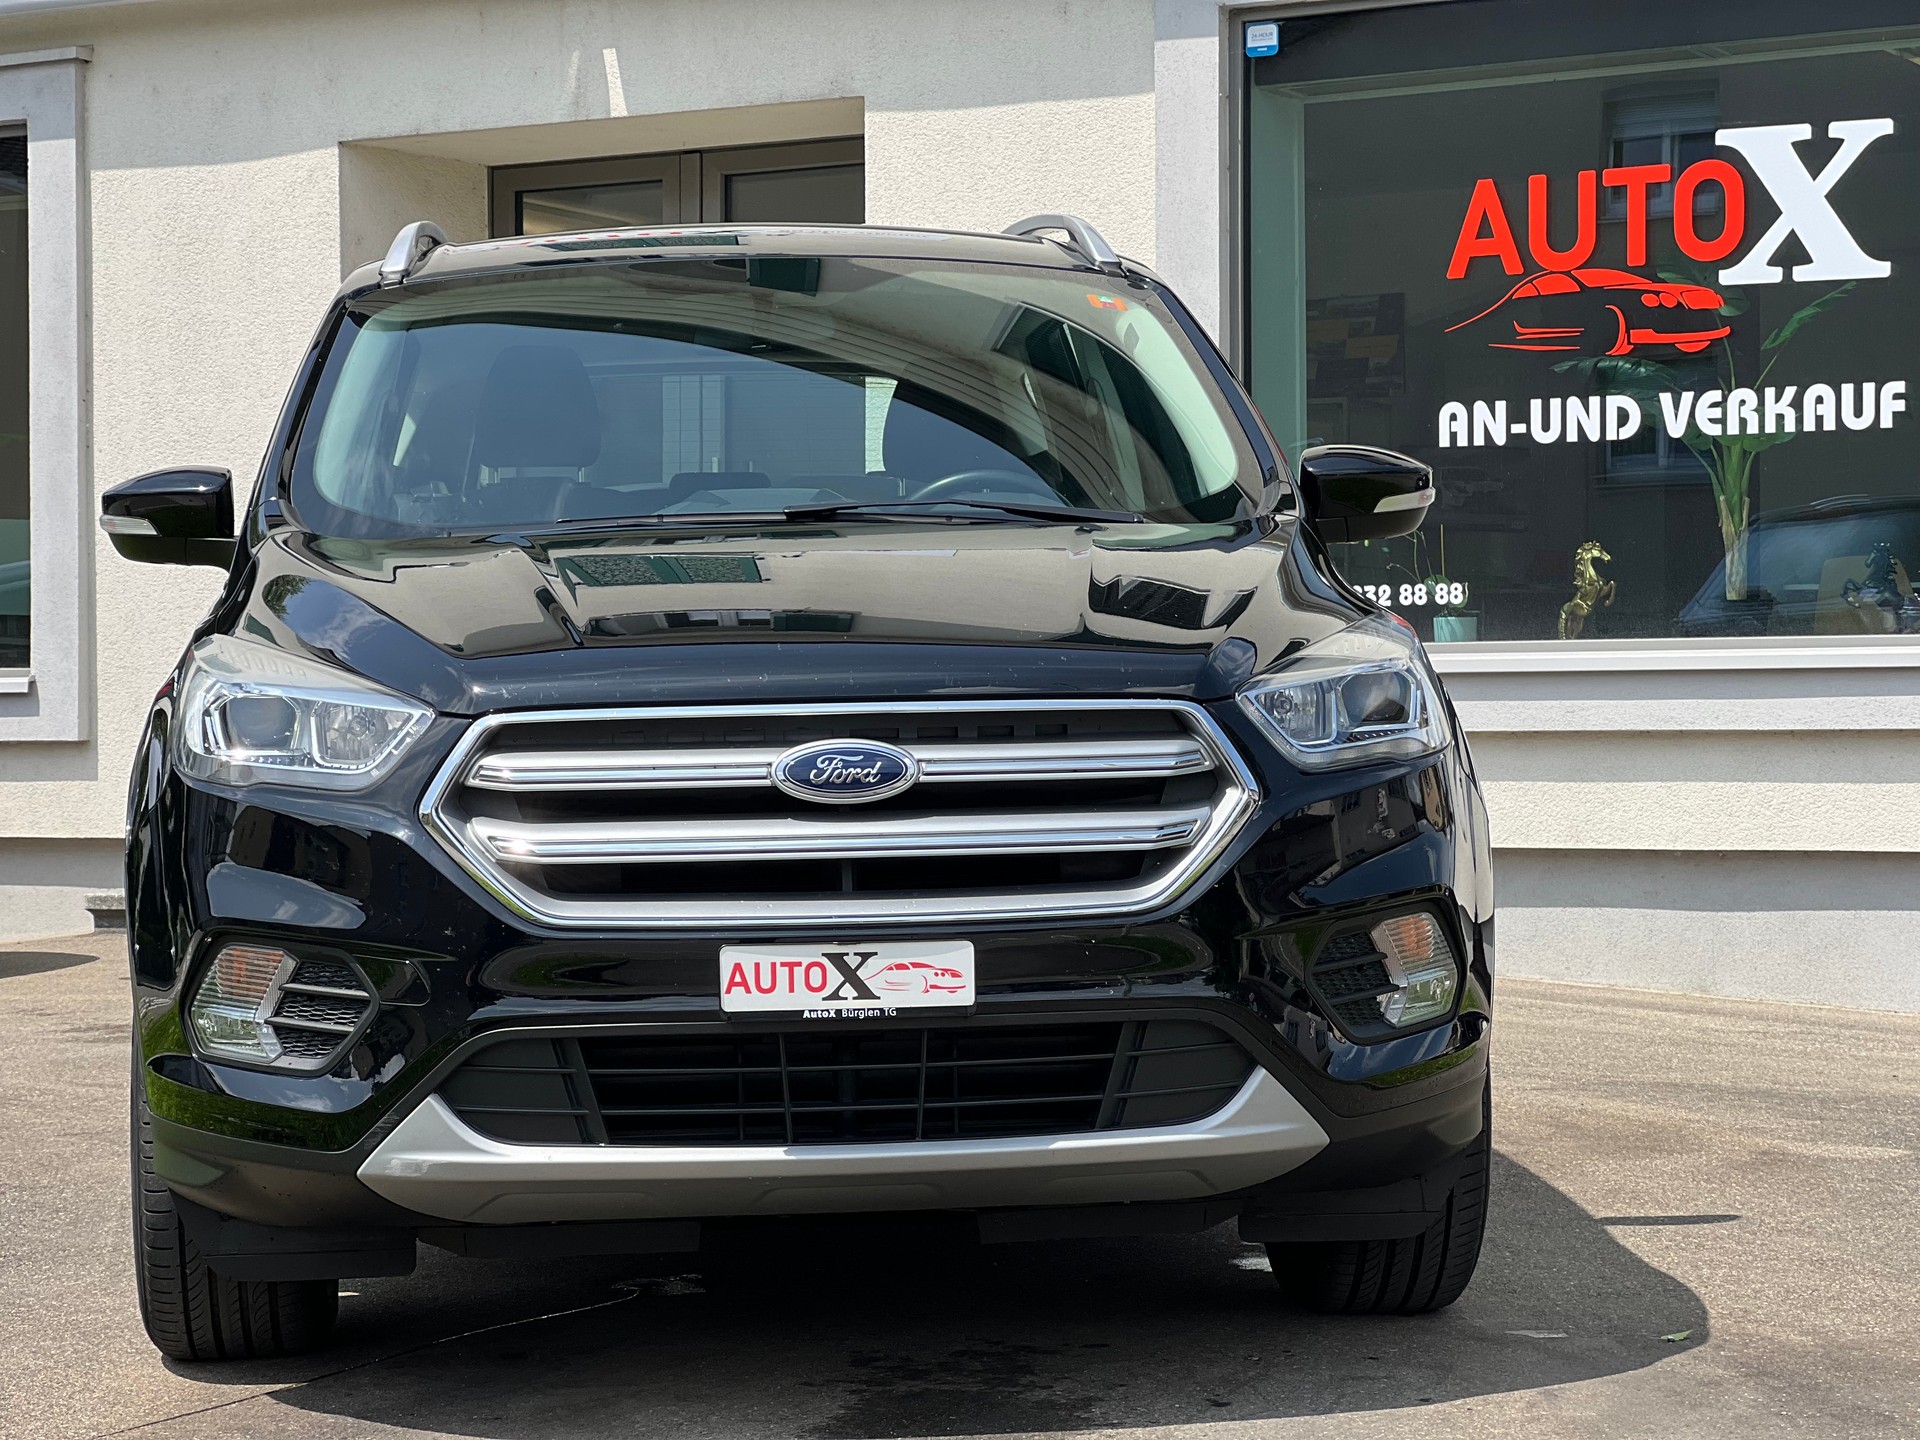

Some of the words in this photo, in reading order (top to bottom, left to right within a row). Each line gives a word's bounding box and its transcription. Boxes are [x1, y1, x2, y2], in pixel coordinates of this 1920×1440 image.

[1438, 393, 1642, 448] AN-UND
[1658, 380, 1907, 440] VERKAUF
[1399, 583, 1428, 606] 88
[1434, 582, 1464, 605] 88
[809, 753, 882, 786] Ford
[802, 1008, 837, 1019] AutoX
[841, 1007, 880, 1019] Bürglen
[883, 1007, 897, 1017] TG
